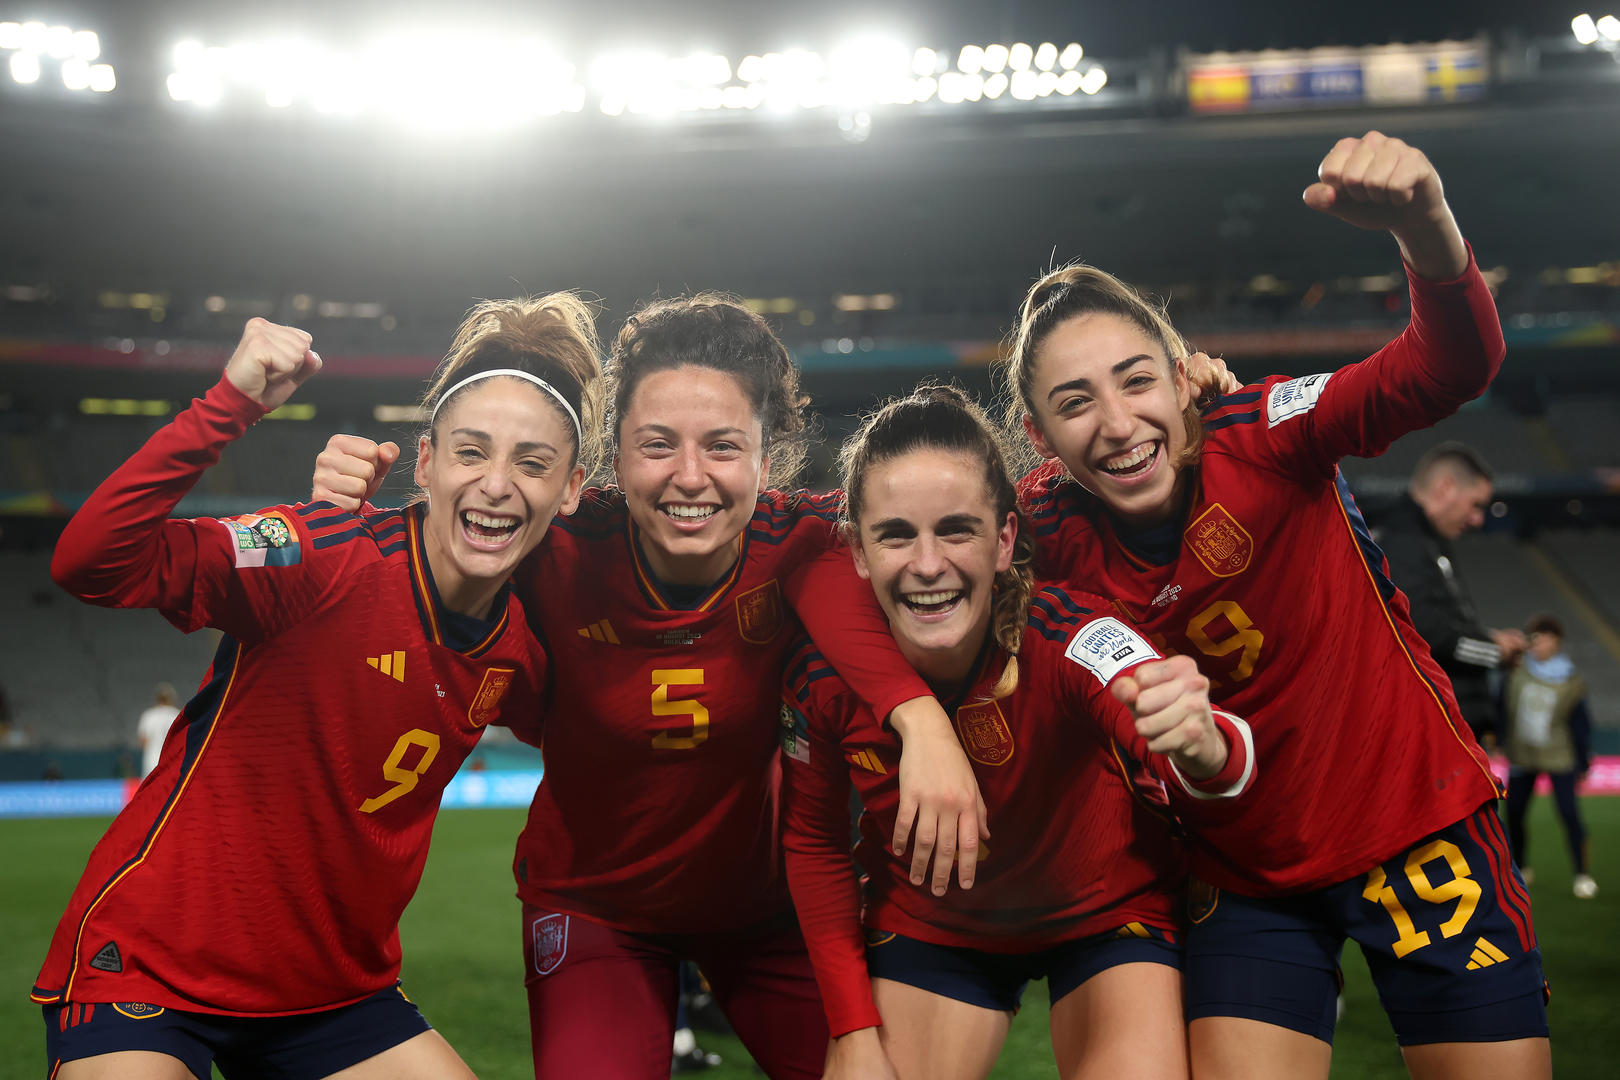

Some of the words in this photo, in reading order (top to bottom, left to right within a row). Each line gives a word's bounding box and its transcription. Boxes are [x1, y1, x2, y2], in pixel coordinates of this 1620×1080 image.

[1081, 624, 1116, 650] FOOTBALL
[1088, 627, 1125, 655] UNITES
[1108, 634, 1136, 652] World
[1113, 647, 1132, 659] FIFA
[651, 668, 710, 750] 5
[358, 728, 441, 814] 9
[1362, 839, 1483, 960] 19
